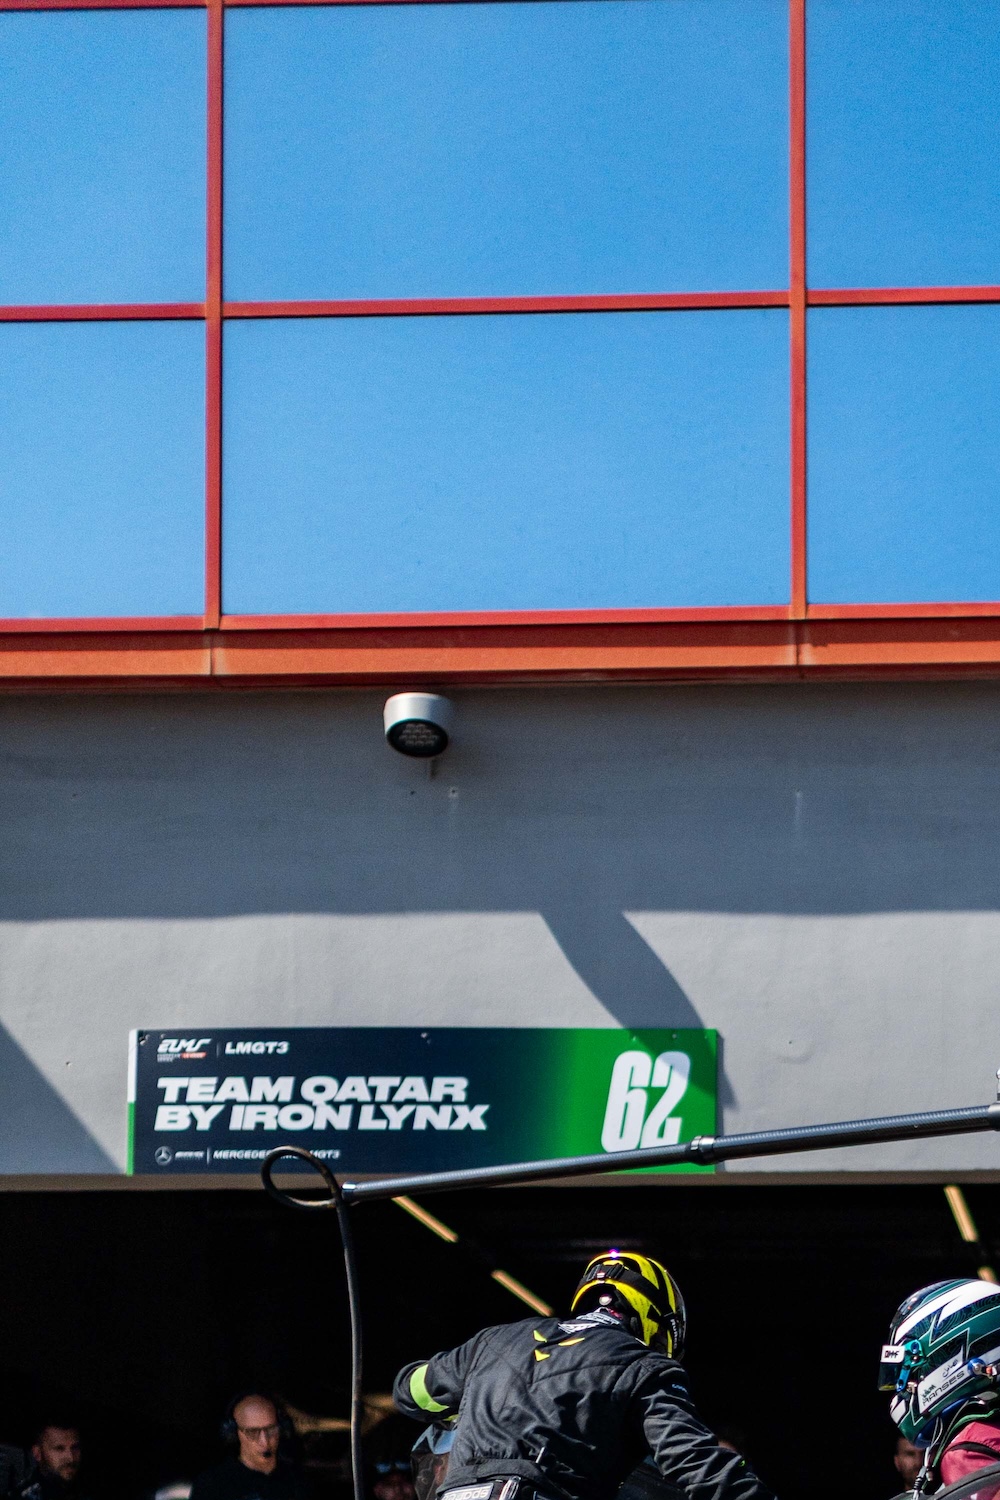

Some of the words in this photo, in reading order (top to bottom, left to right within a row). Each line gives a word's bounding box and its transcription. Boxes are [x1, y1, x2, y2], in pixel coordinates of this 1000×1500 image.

[225, 1041, 290, 1055] LMGT3
[157, 1076, 295, 1102] TEAM
[300, 1076, 468, 1106] QATAR
[601, 1051, 690, 1152] 62
[154, 1105, 224, 1131] BY
[229, 1105, 356, 1131] IRON
[358, 1105, 488, 1131] LYNX
